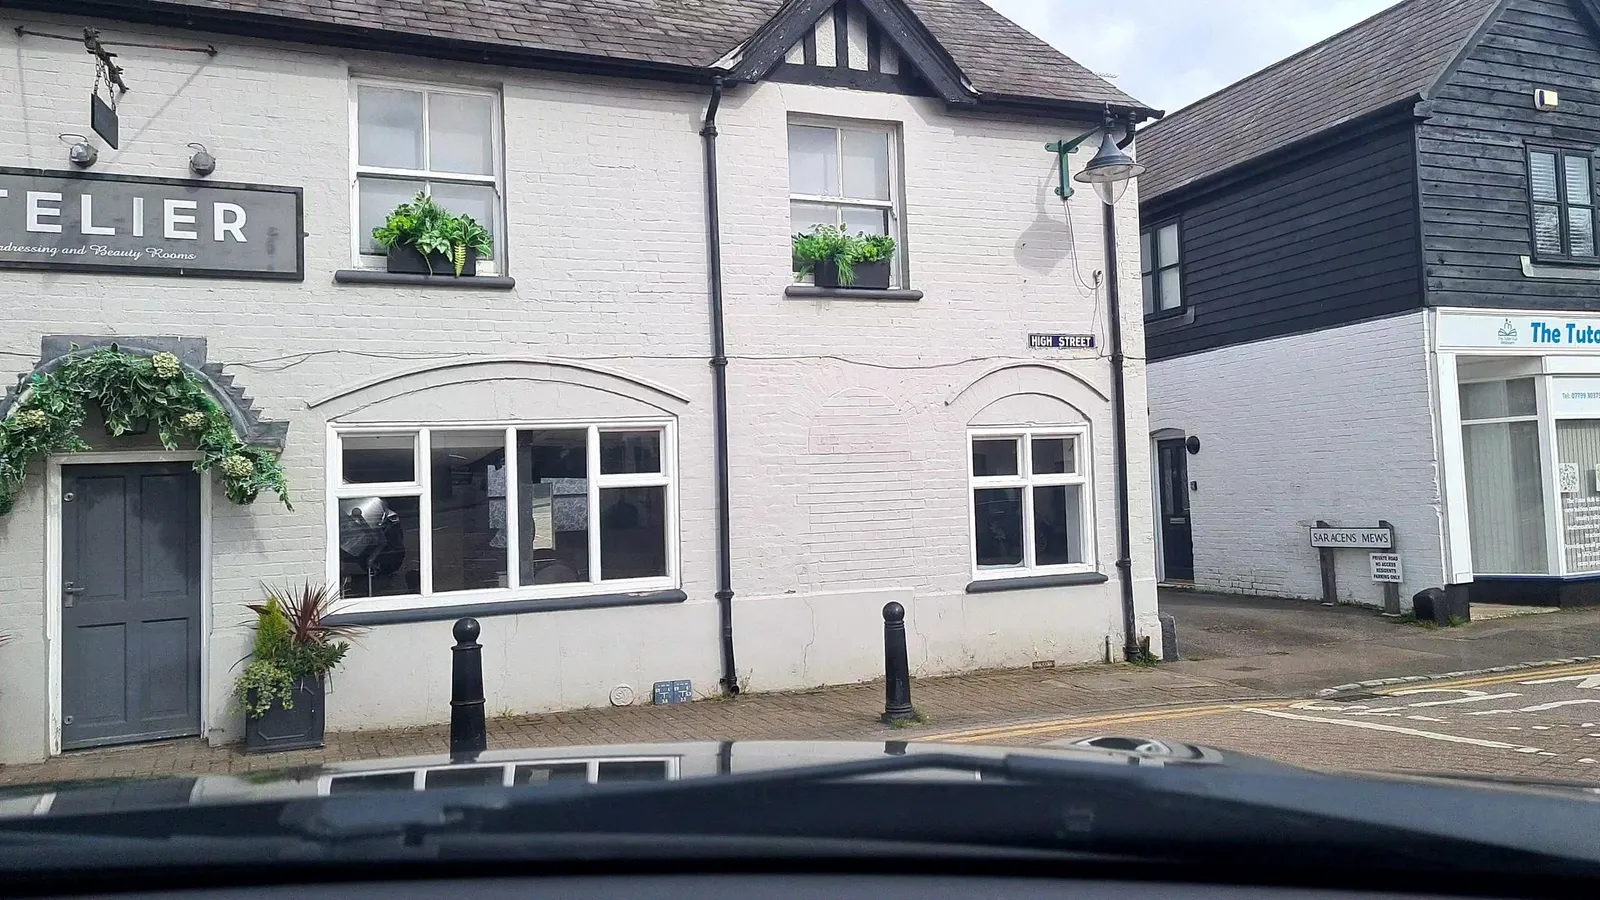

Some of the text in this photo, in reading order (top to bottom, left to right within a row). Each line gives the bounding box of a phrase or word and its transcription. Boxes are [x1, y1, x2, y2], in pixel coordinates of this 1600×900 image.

[0, 189, 248, 243] ELIER
[61, 245, 87, 255] and
[89, 244, 143, 260] Beauty
[145, 247, 196, 260] Rooms
[1530, 322, 1561, 343] The
[1031, 335, 1091, 347] HIGH STREET
[1313, 532, 1389, 543] SARACENS MEWS
